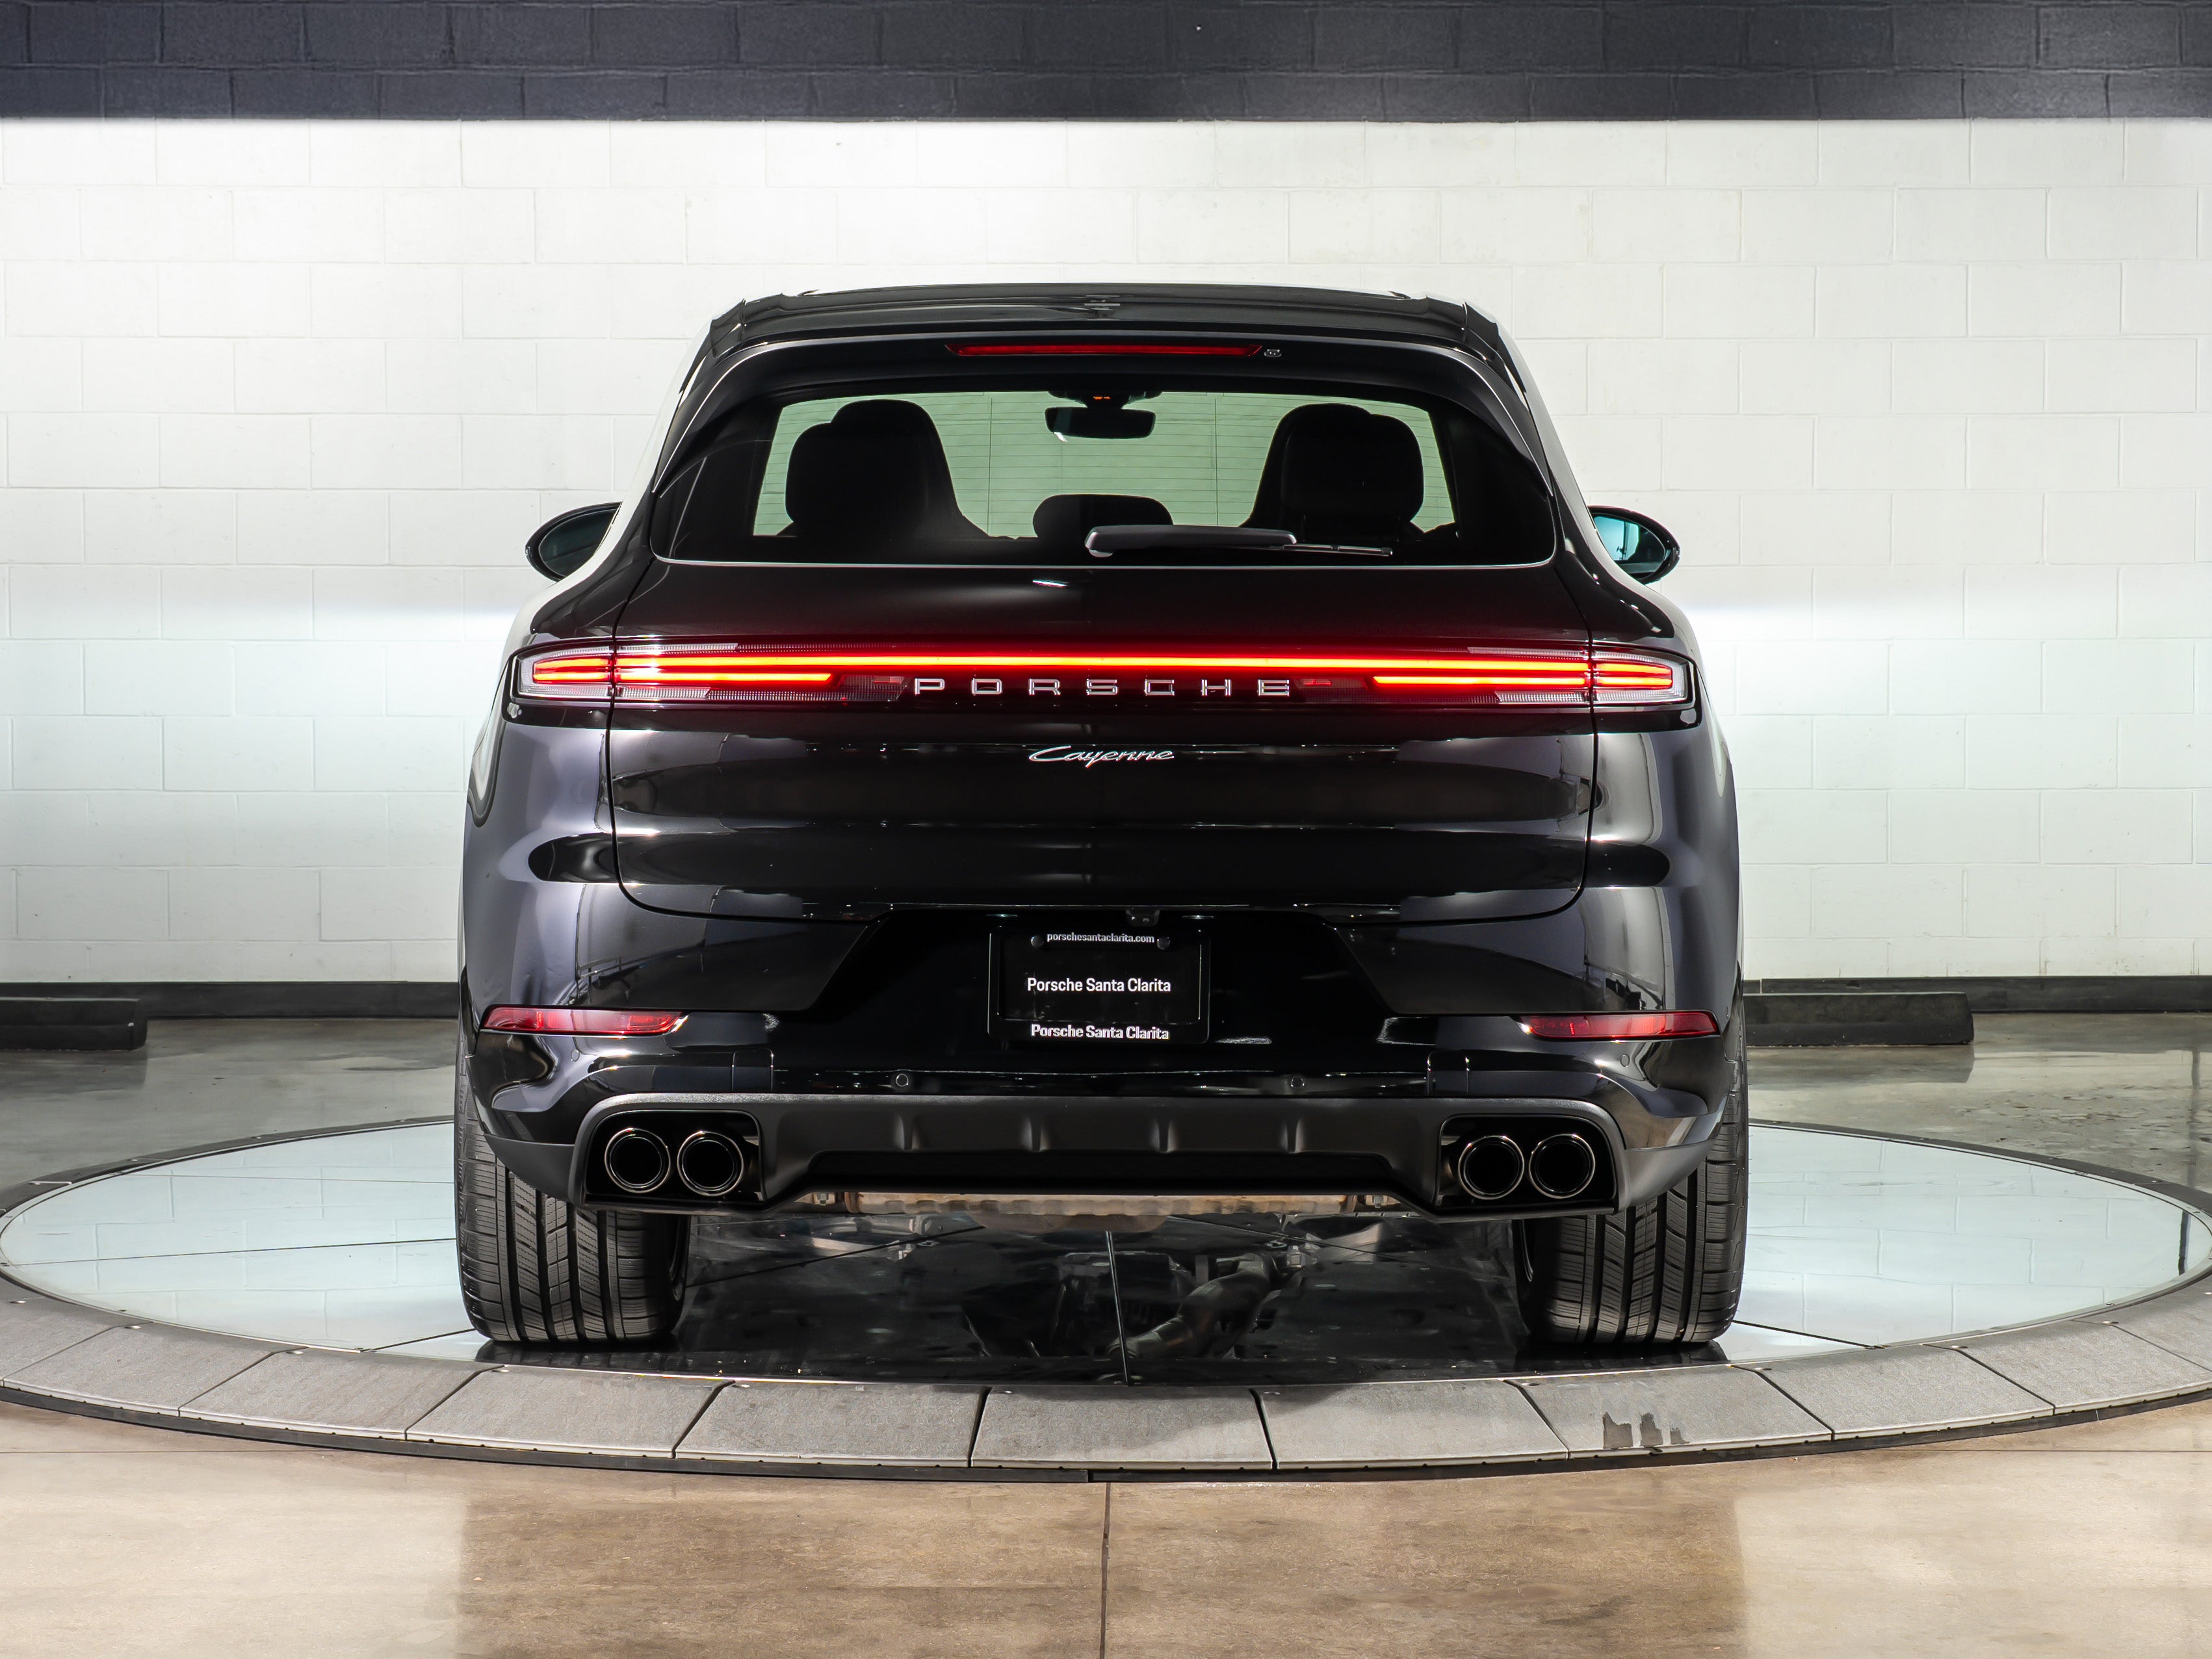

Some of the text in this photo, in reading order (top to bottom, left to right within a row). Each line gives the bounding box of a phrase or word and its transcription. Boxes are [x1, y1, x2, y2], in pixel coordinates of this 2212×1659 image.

[913, 677, 1291, 697] PORSCHE
[1028, 745, 1175, 768] Cayenne
[1047, 932, 1155, 943] porschesantaclarita.com
[1027, 977, 1171, 993] Porsche Santa Clarita
[1030, 1023, 1169, 1039] Porsche Santa Clarita
